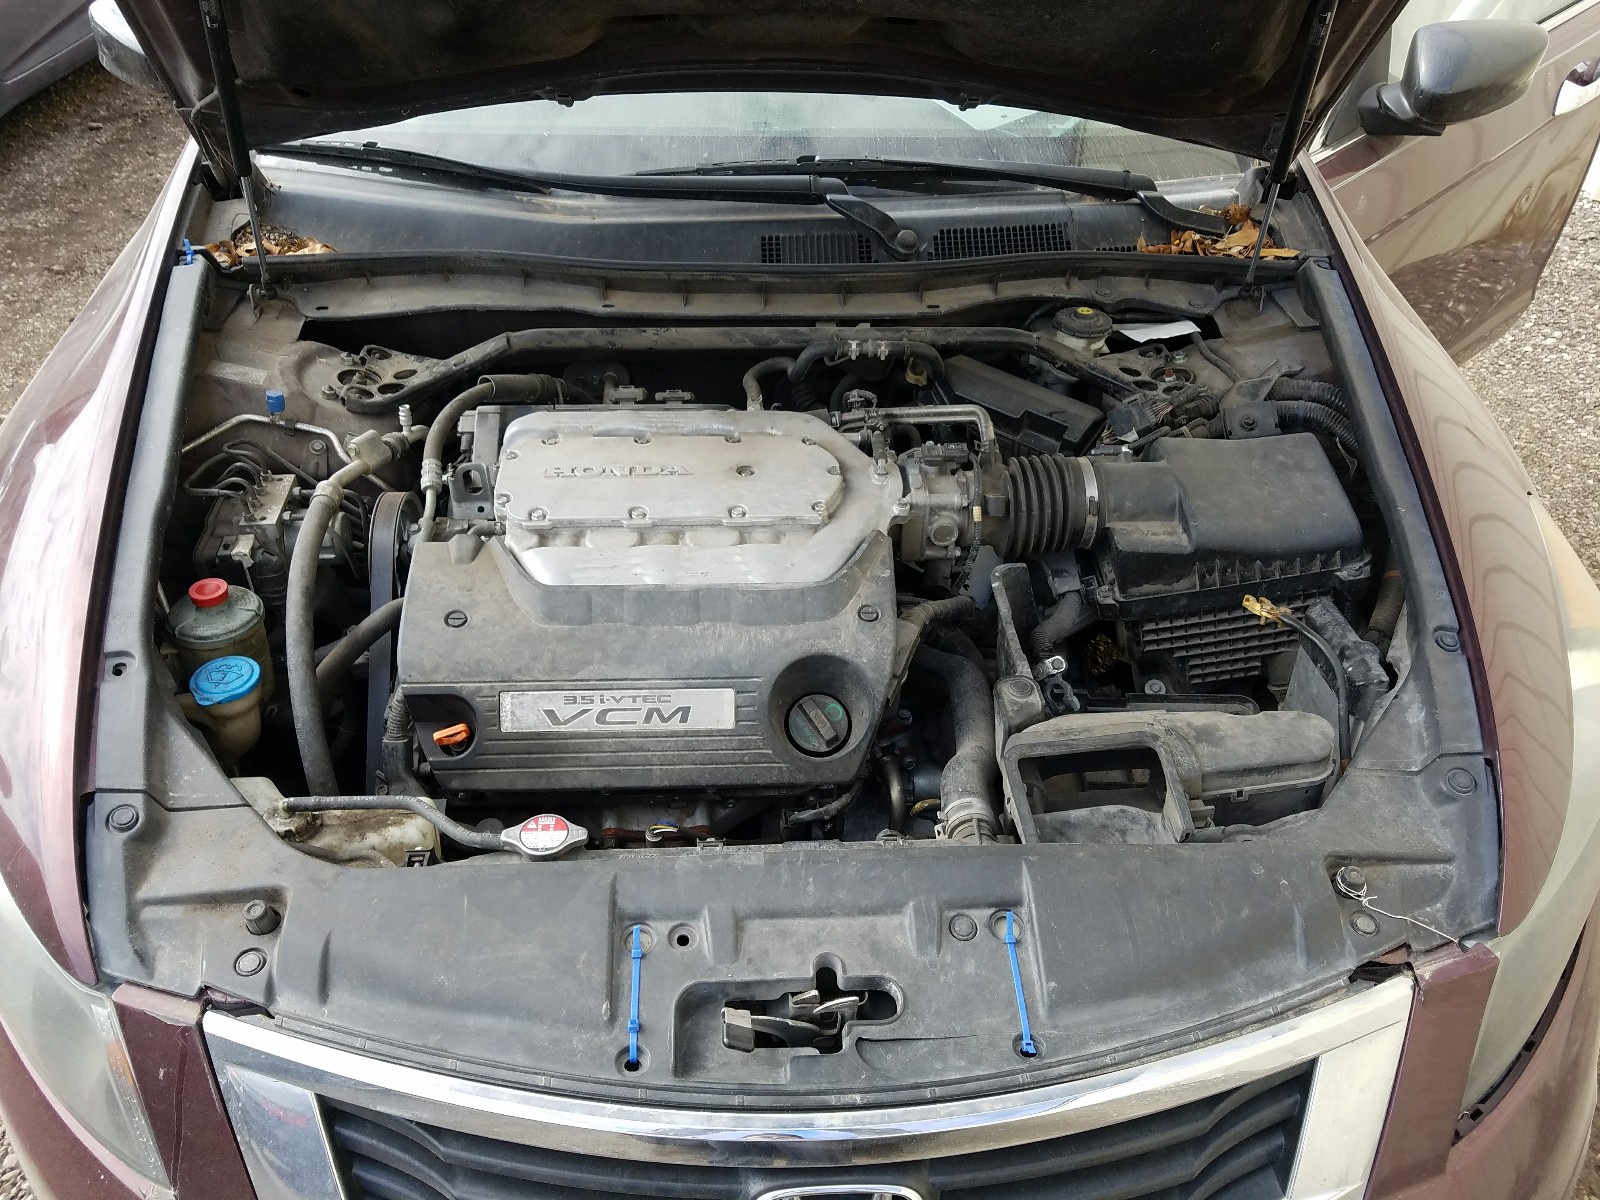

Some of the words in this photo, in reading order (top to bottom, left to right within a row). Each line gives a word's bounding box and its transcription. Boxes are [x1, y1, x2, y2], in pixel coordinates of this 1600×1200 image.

[543, 464, 694, 478] HONDA
[563, 695, 594, 706] 3.5
[599, 694, 672, 705] i-VTEC
[540, 705, 692, 727] VCM
